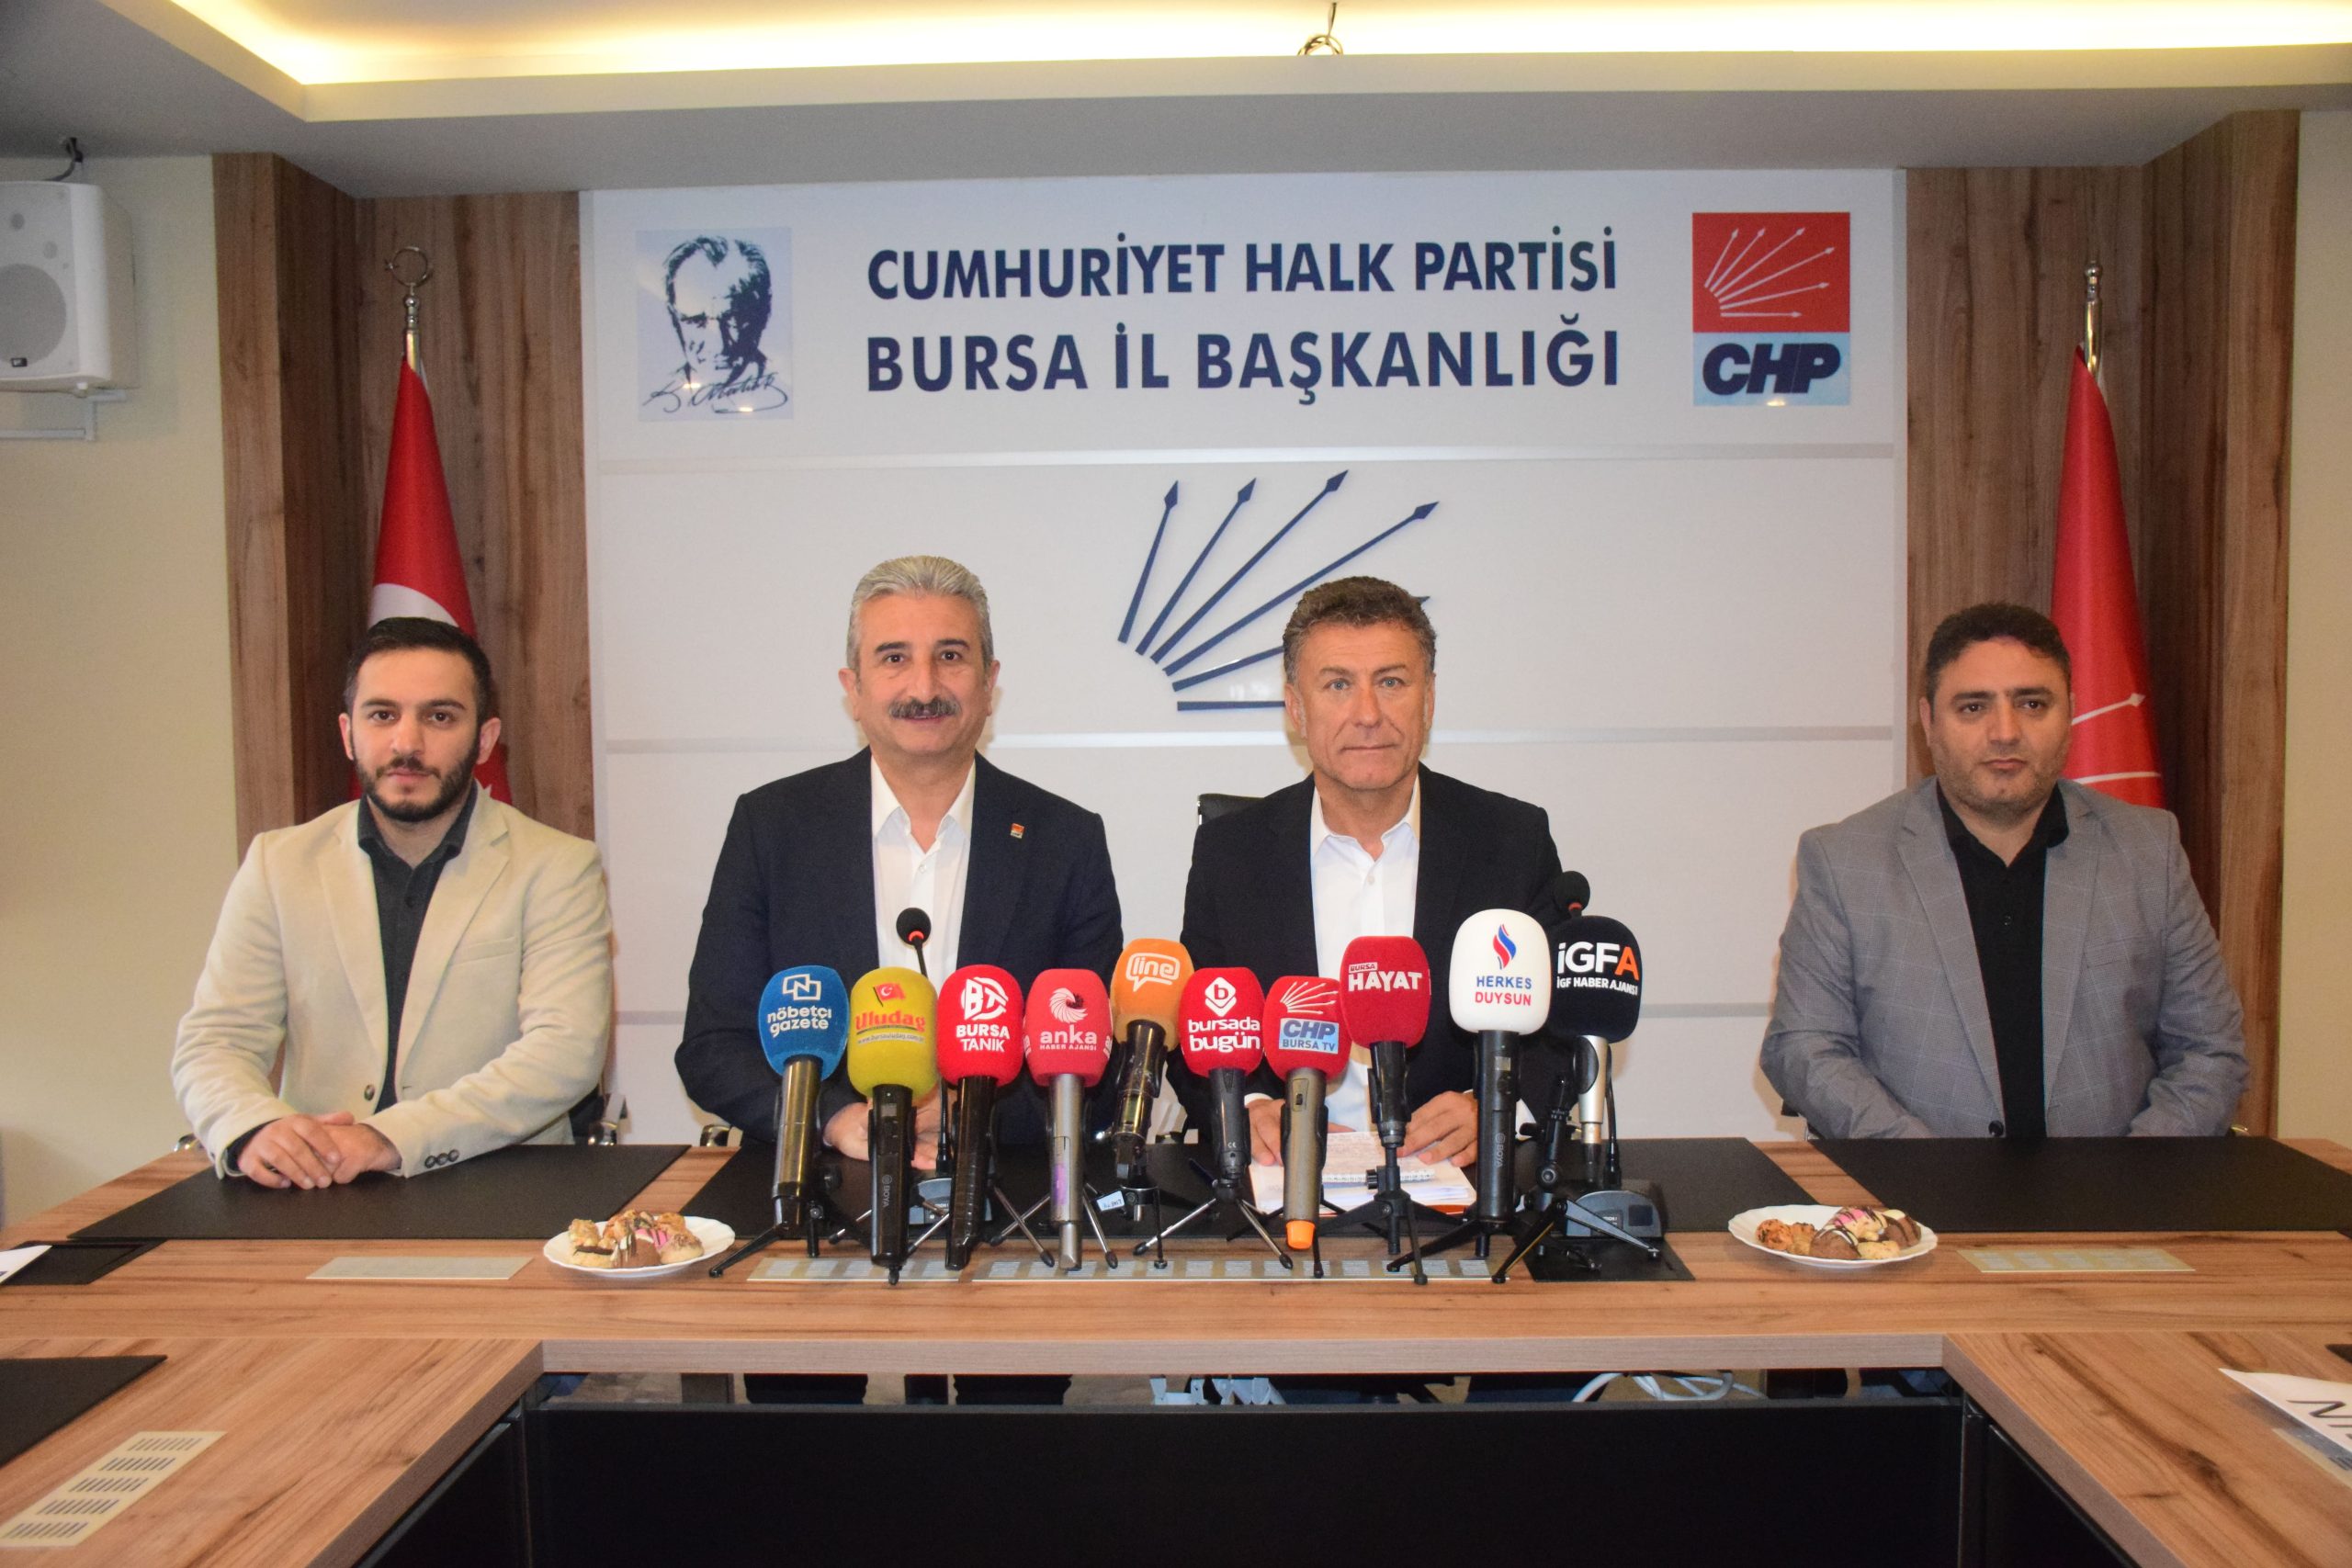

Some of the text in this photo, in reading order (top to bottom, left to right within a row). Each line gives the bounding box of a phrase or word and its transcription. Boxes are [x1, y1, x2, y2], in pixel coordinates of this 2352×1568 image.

[867, 225, 1616, 300] CUMHURİYET HALK PARTİSİ
[867, 316, 1618, 405] BURSA İL BAŞKANLIĞI
[1702, 343, 1840, 395] CHP
[1132, 955, 1175, 976] line
[1350, 964, 1376, 972] BURSA
[1348, 971, 1423, 992] HAYAT
[1476, 976, 1532, 989] HERKES
[1573, 977, 1609, 989] HABER
[1609, 980, 1638, 996] AJANSI
[1475, 992, 1532, 1006] DUYSUN
[770, 1017, 829, 1038] gazete
[956, 1023, 1010, 1039] BURSA
[1039, 1024, 1097, 1044] anka
[1188, 1016, 1261, 1033] bursada
[1283, 1020, 1336, 1040] CHP
[960, 1038, 1005, 1052] TANIK
[1189, 1032, 1261, 1053] bugün
[1282, 1039, 1337, 1052] BURSA TV
